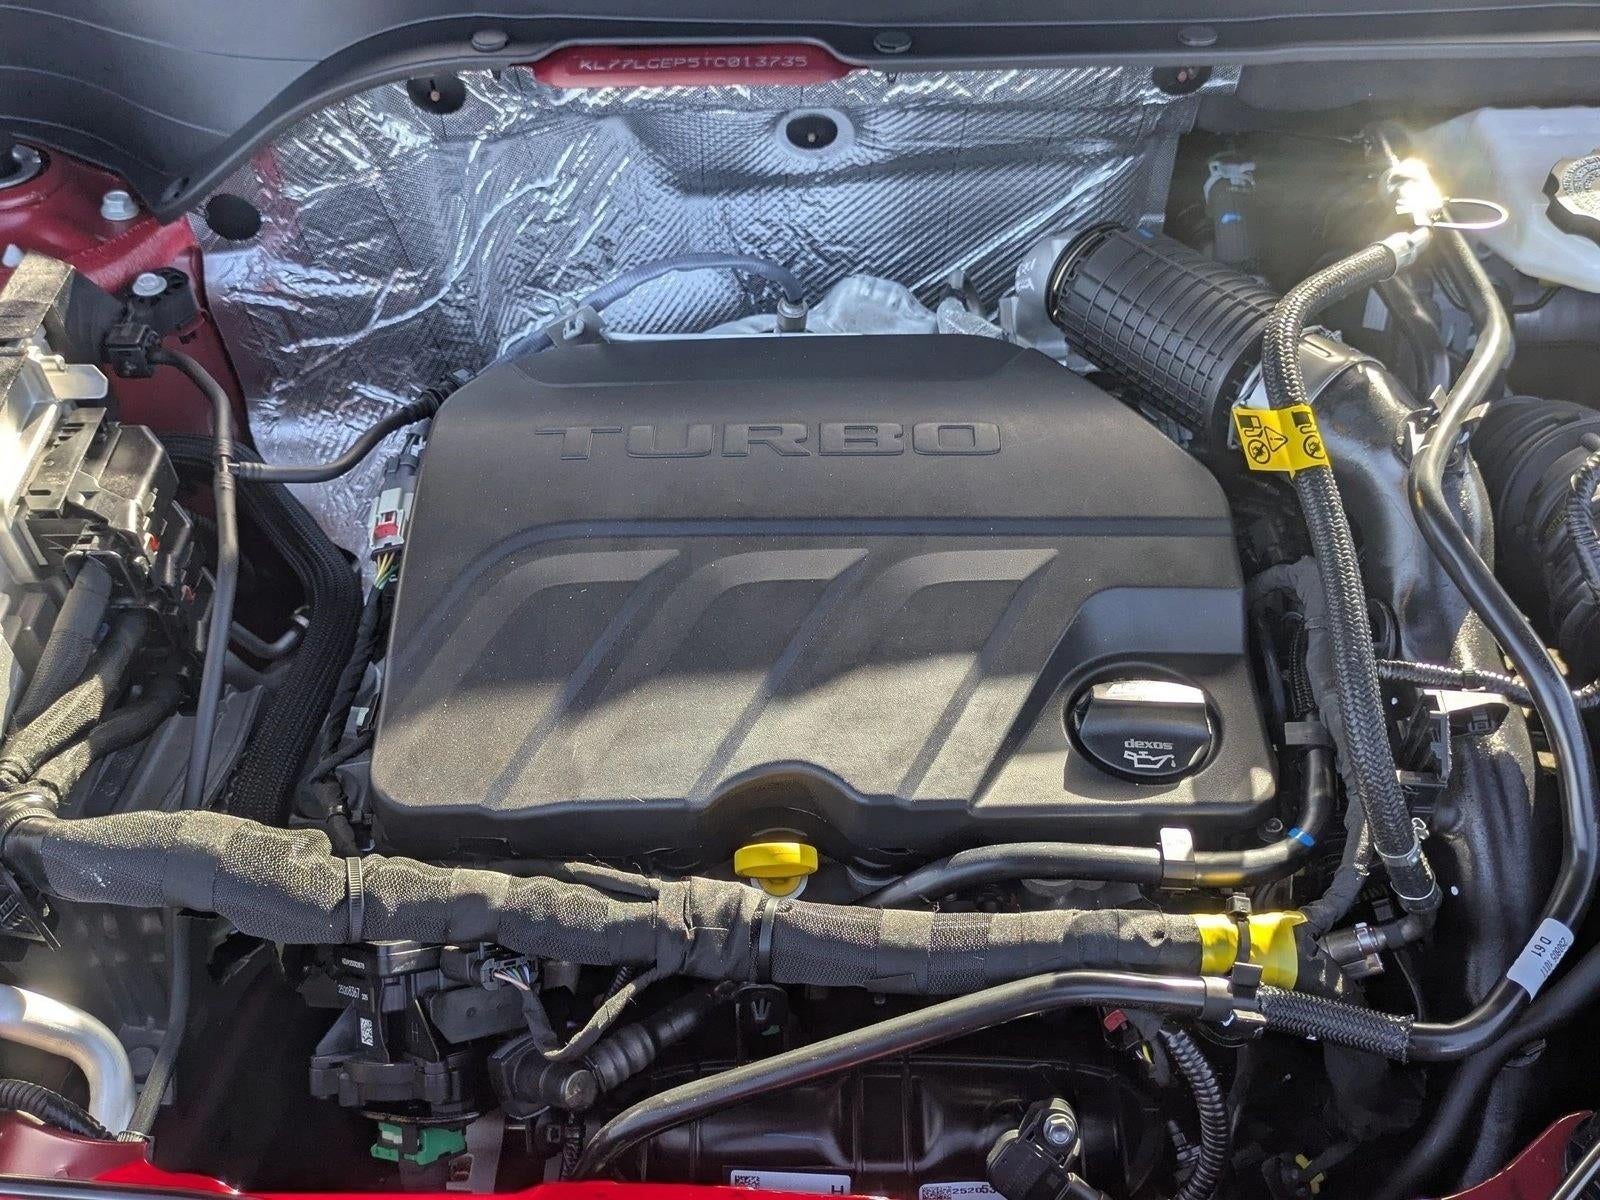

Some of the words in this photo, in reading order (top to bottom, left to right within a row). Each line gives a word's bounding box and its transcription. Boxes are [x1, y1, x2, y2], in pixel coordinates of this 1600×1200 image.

[578, 55, 808, 71] KL77LGEP5TC013735
[534, 421, 1002, 460] TURBO
[1124, 738, 1174, 750] dexos
[1531, 944, 1546, 957] 61
